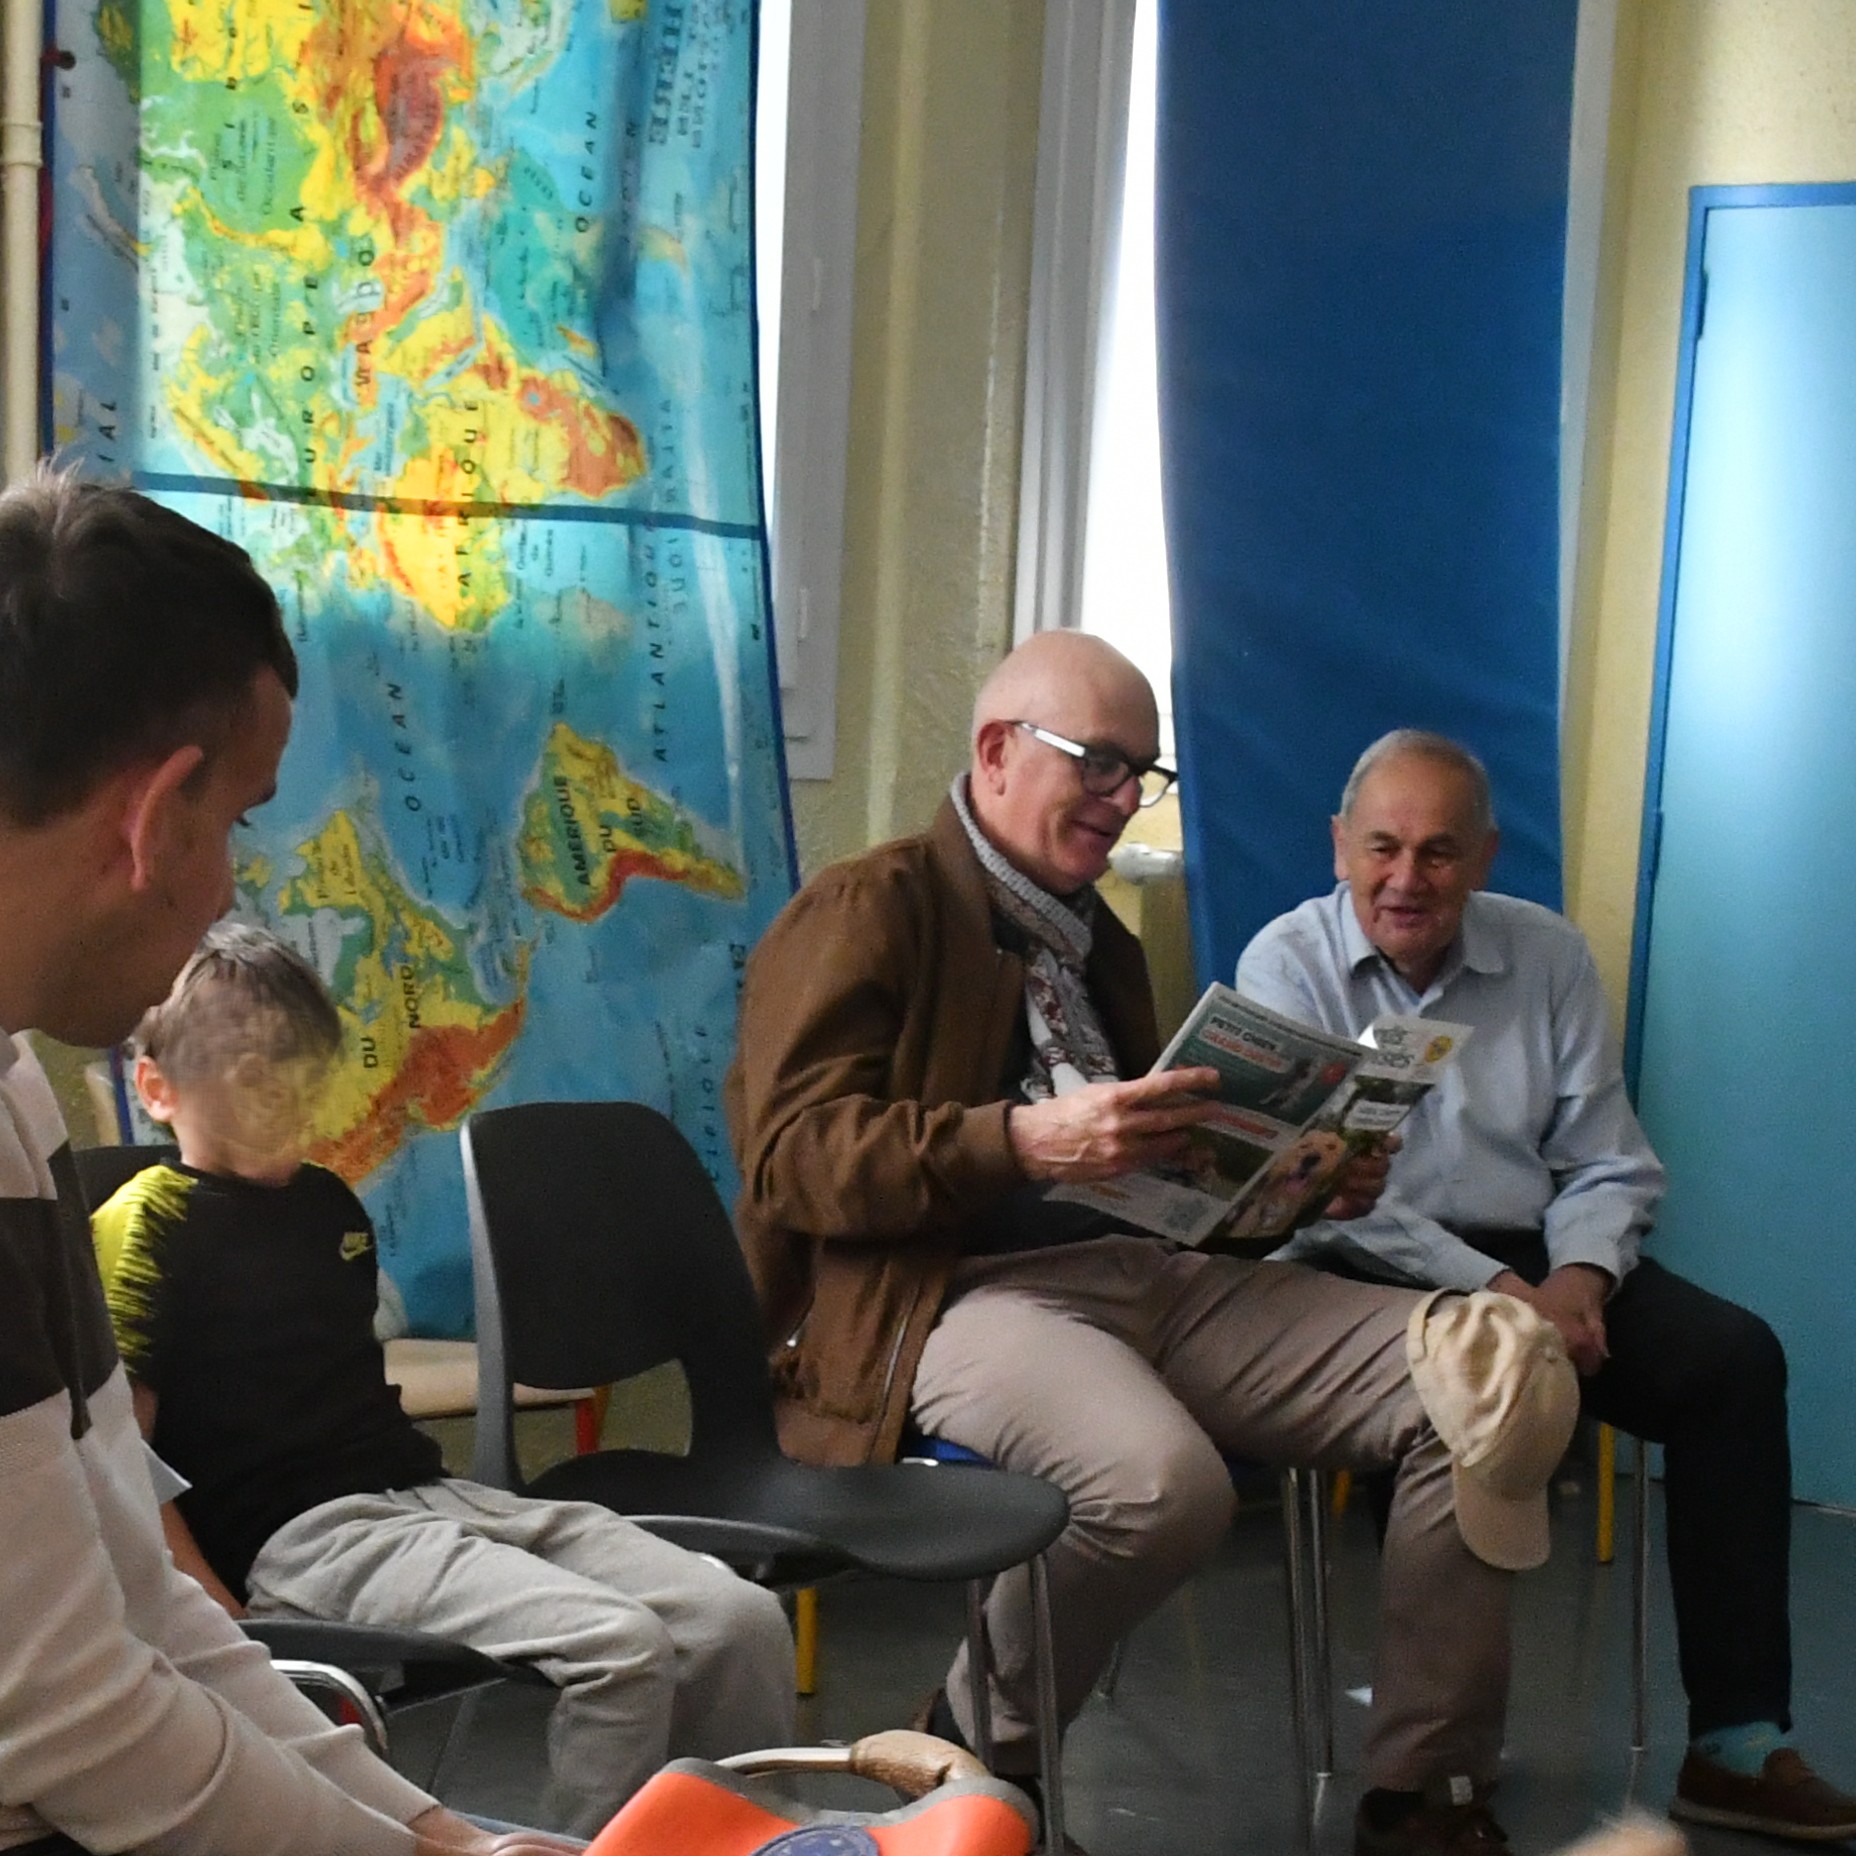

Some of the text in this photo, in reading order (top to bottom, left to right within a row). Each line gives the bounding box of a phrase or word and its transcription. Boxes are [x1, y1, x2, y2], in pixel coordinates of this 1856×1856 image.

[576, 110, 598, 233] OCEAN
[387, 683, 423, 812] OCEAN
[598, 824, 619, 854] DU
[626, 796, 643, 838] SUD
[398, 963, 422, 1030] NORD
[360, 1036, 379, 1069] DU
